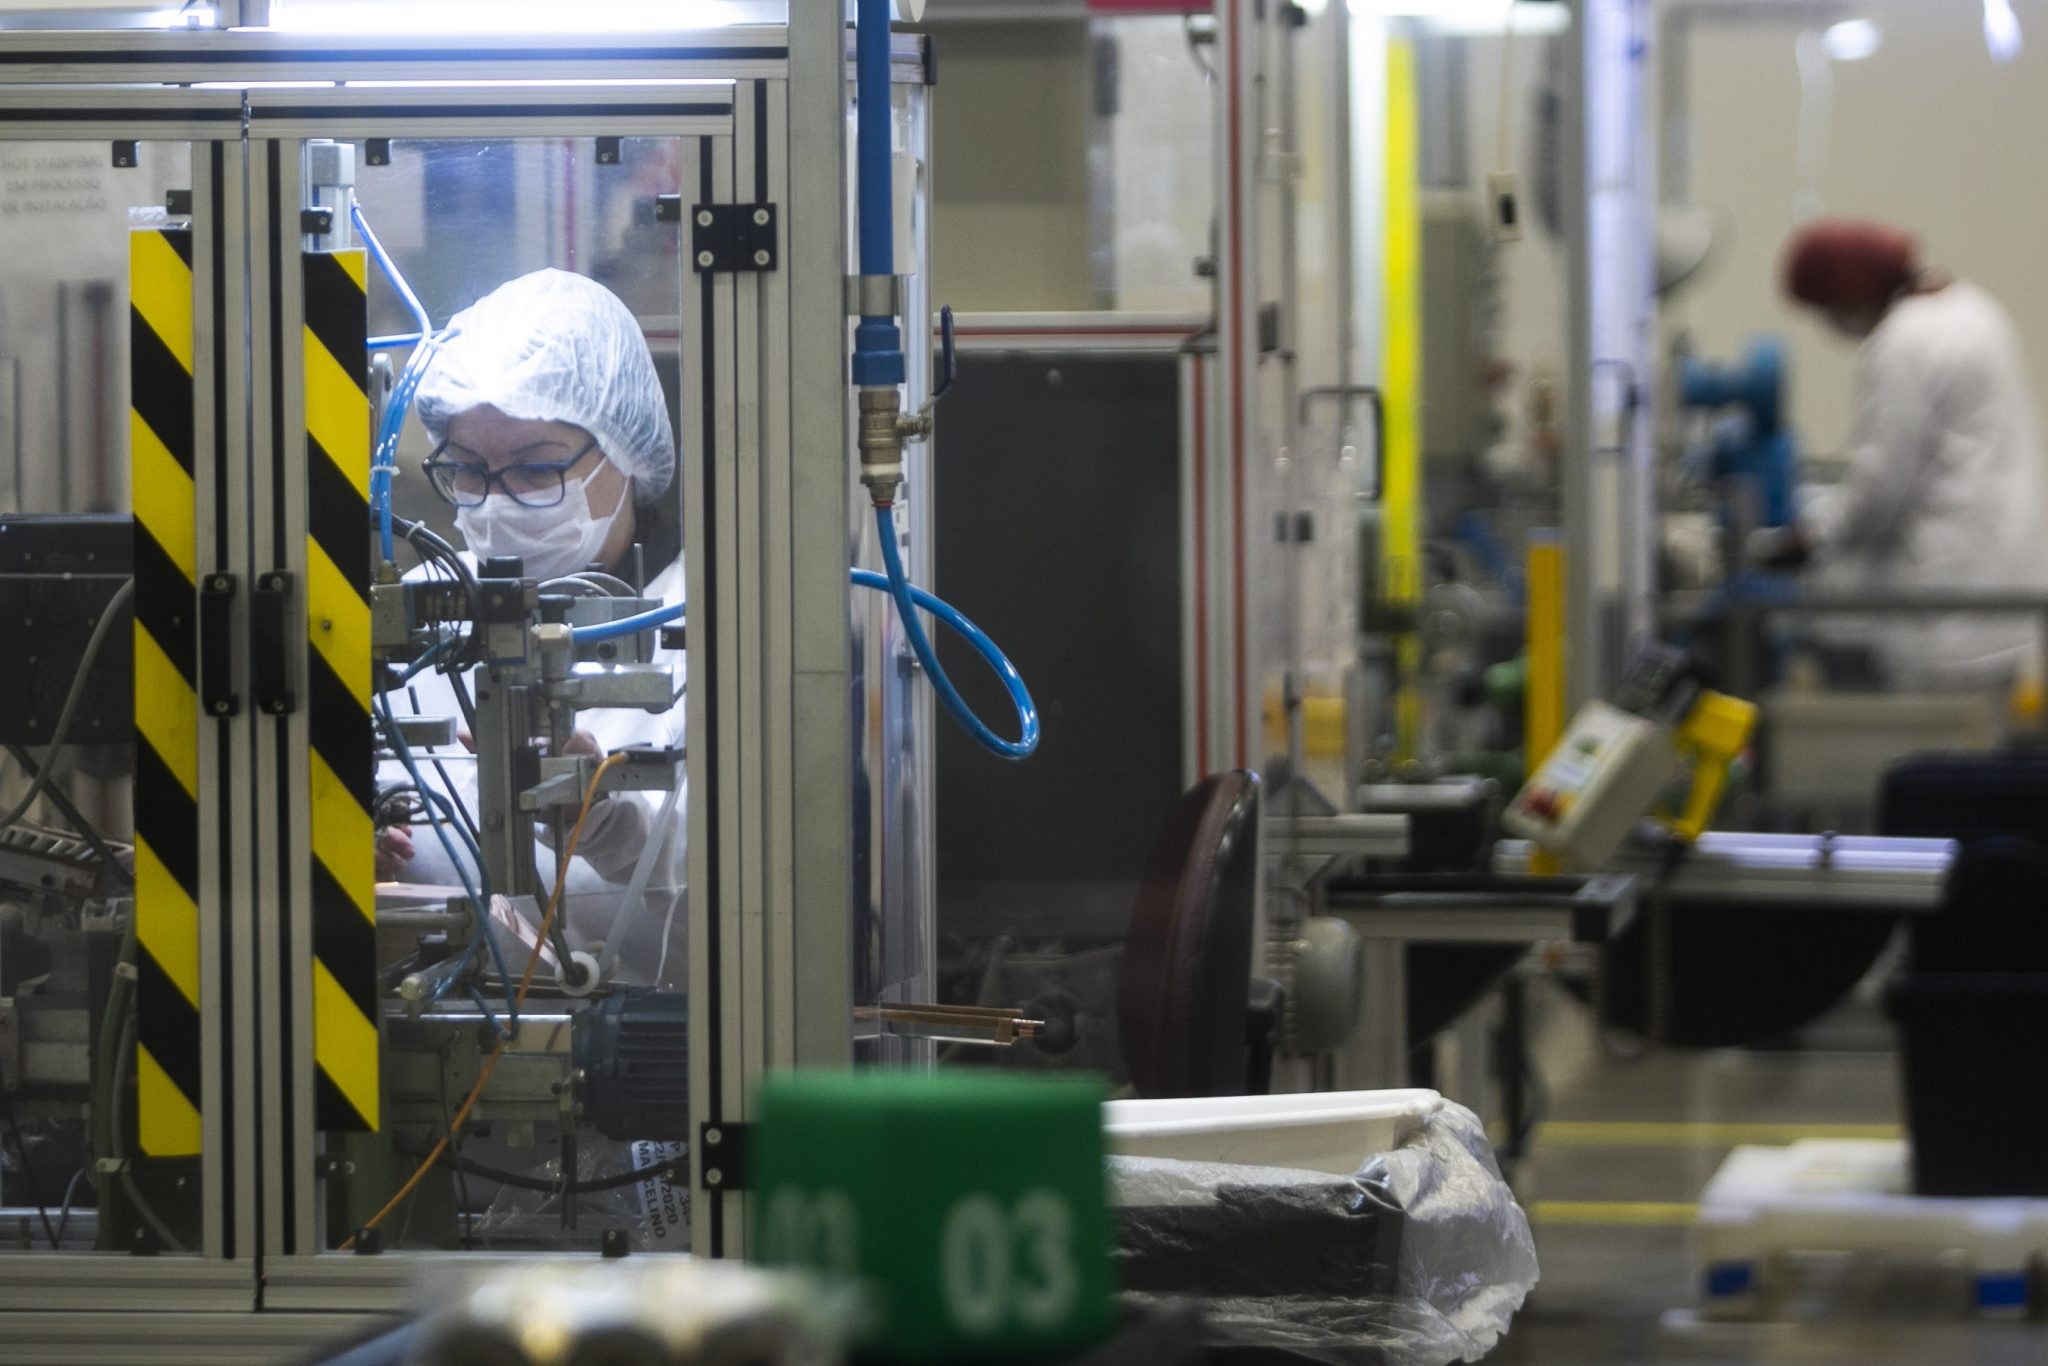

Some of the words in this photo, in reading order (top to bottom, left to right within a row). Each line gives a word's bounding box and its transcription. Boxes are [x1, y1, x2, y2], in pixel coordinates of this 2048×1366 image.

[34, 154, 104, 169] STAMPING
[32, 177, 101, 191] PROCESSO
[2, 200, 20, 214] DE
[638, 1142, 667, 1238] MACELINO
[944, 1190, 1077, 1330] 03
